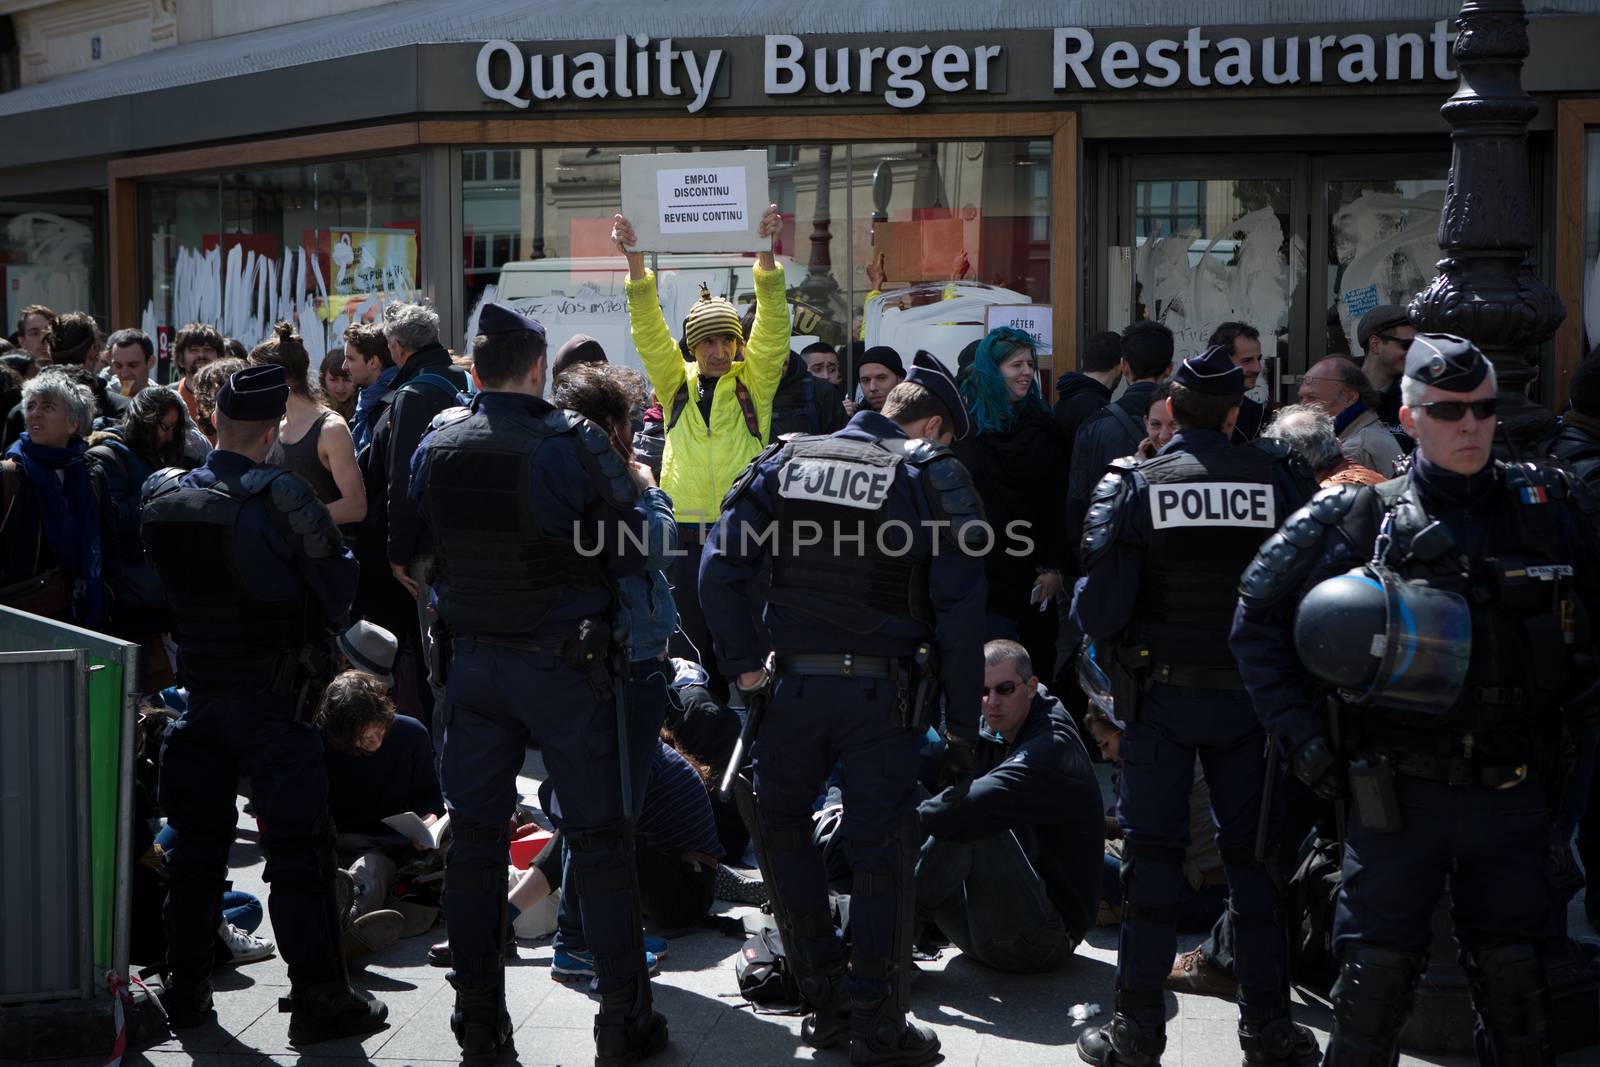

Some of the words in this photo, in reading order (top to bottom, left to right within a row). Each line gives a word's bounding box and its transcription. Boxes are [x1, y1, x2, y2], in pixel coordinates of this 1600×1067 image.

[475, 33, 722, 113] Quality
[764, 34, 1001, 108] Burger
[1052, 19, 1458, 89] Restaurant
[684, 174, 718, 185] EMPLOI
[674, 186, 730, 198] DISCONTINU
[664, 213, 699, 223] REVENU
[702, 211, 743, 222] CONTINU
[783, 463, 888, 505] POLICE
[1159, 487, 1269, 522] POLICE
[1530, 566, 1569, 574] POLICE
